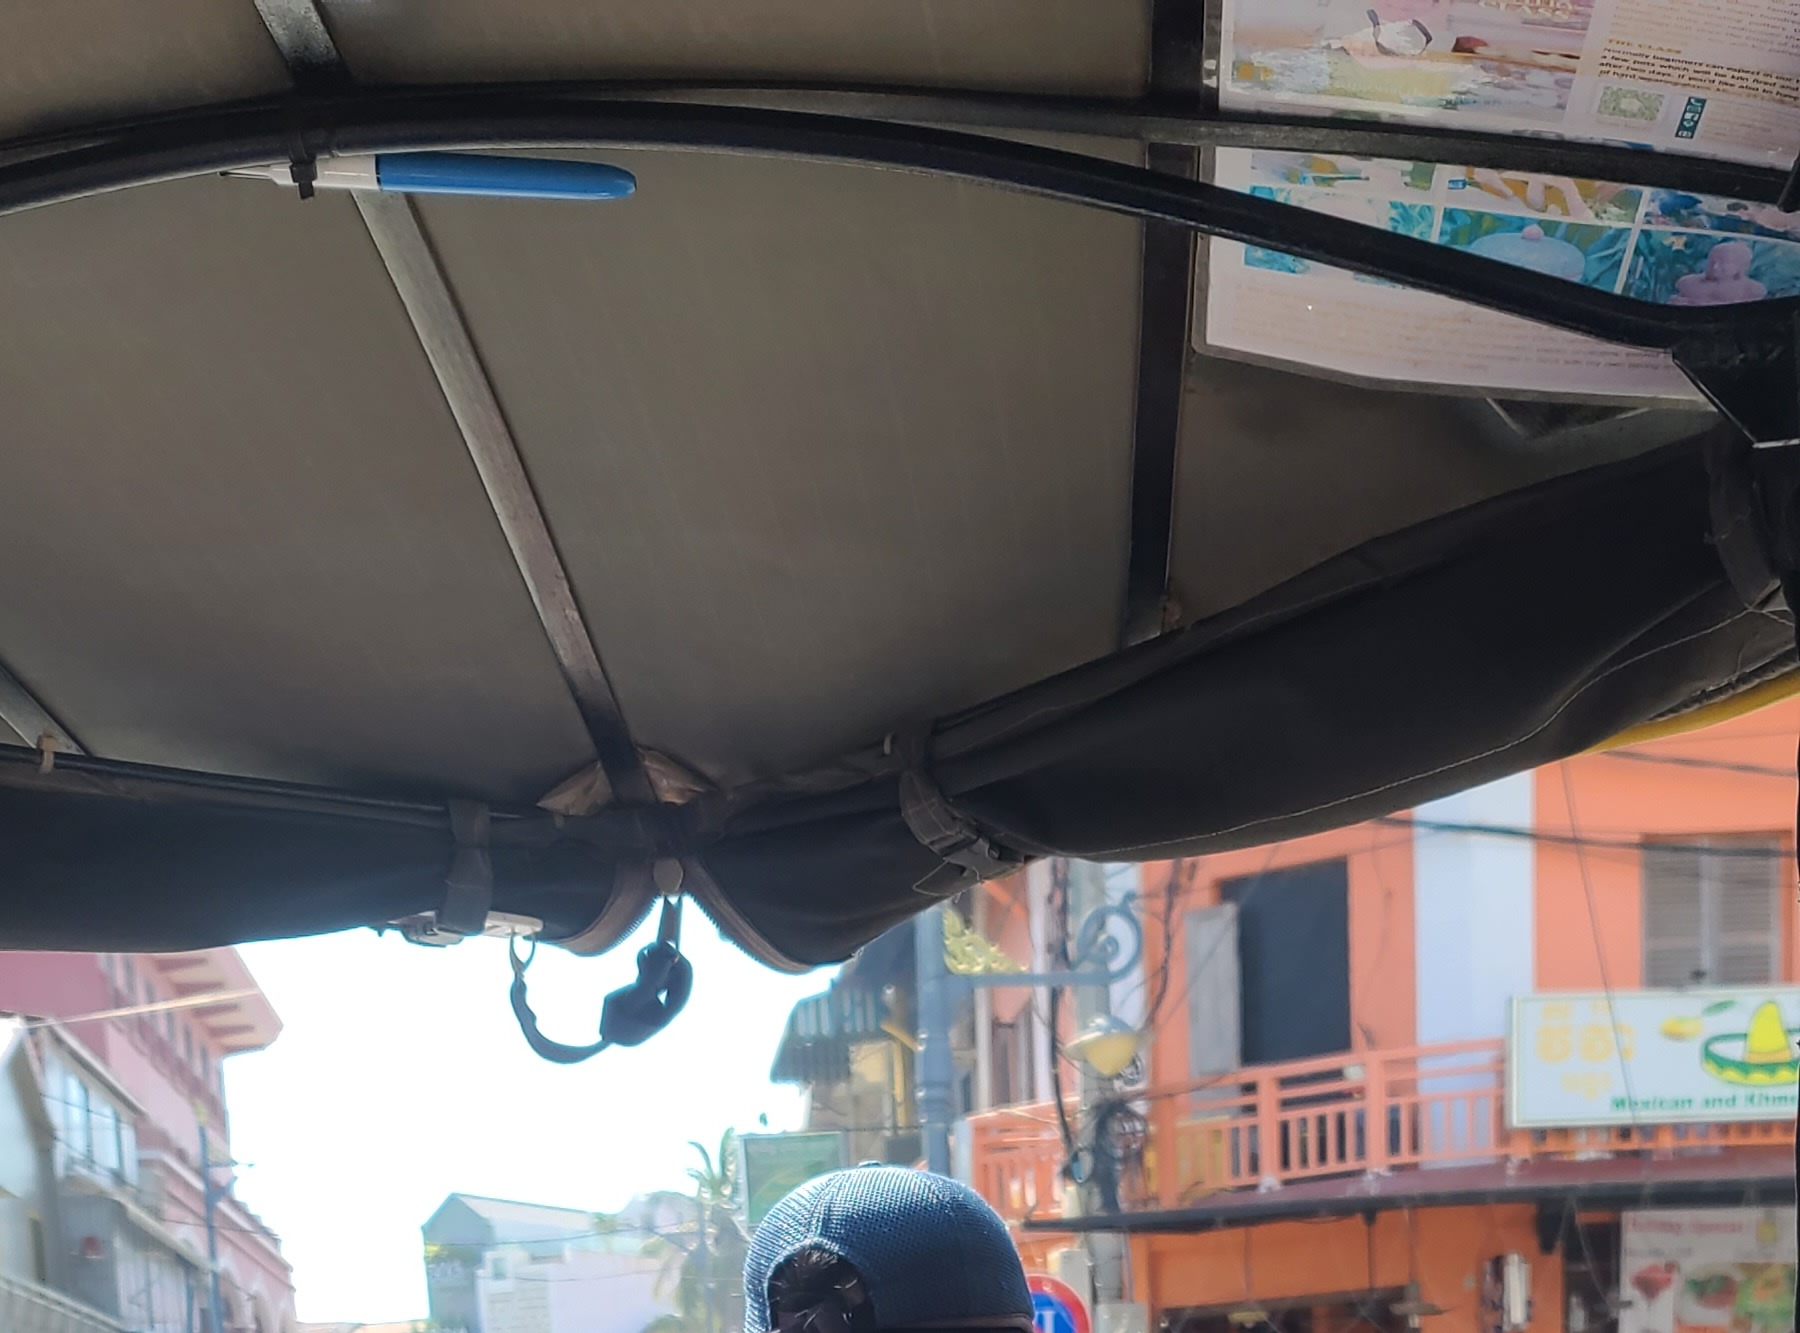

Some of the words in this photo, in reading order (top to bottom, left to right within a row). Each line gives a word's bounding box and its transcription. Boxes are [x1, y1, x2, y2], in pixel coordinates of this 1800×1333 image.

[1598, 62, 1623, 70] after
[1633, 59, 1656, 68] pots
[1659, 64, 1690, 73] which
[1653, 54, 1703, 67] beginners
[1612, 1096, 1693, 1111] Mexican
[1703, 1093, 1737, 1109] and
